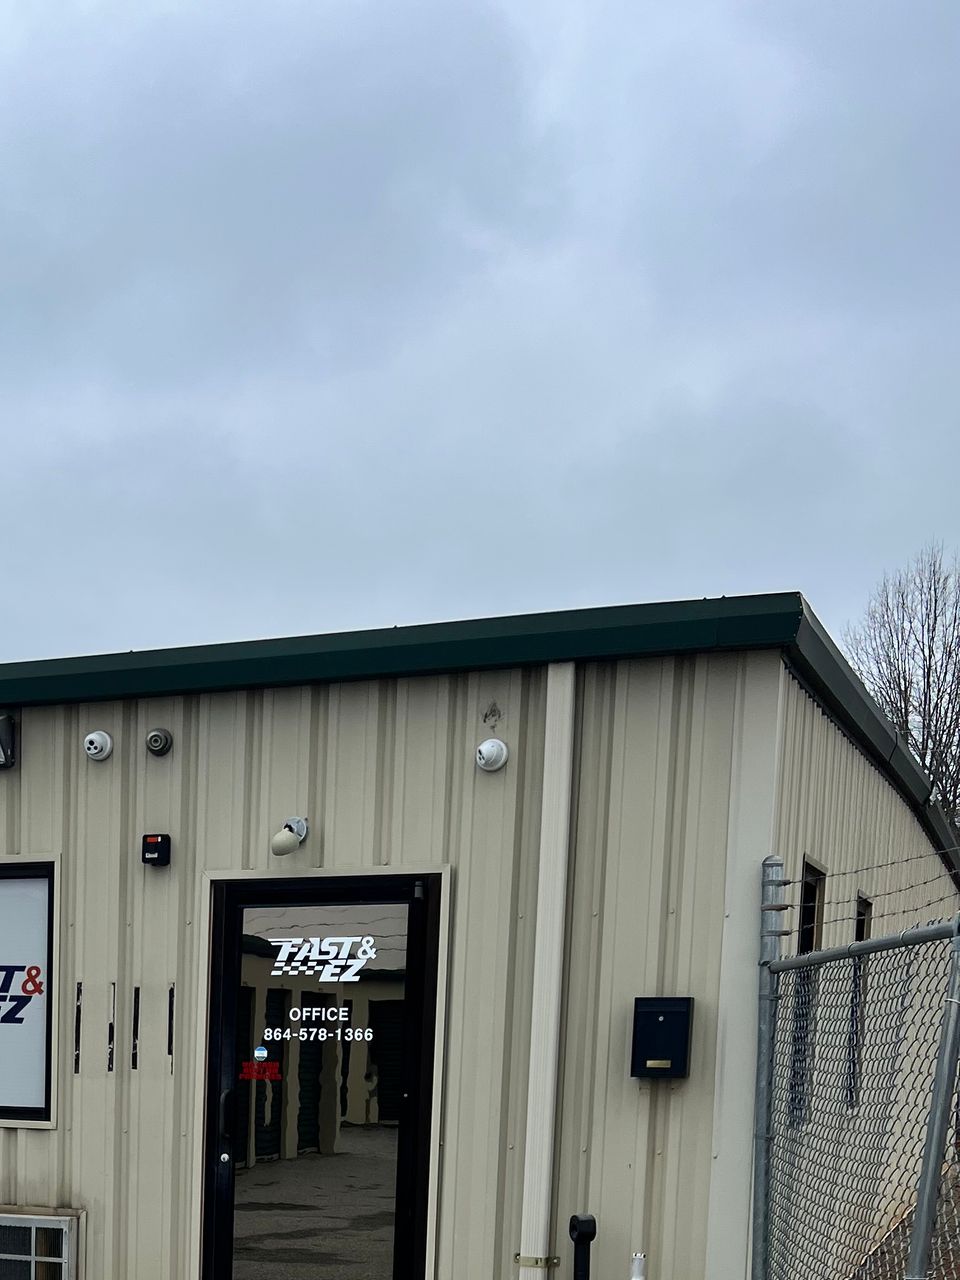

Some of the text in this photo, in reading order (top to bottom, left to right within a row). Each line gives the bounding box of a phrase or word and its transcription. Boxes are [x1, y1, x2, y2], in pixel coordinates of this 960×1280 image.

[318, 959, 368, 983] EZ
[289, 1007, 349, 1021] OFFICE
[263, 1027, 374, 1042] 864-578-1366
